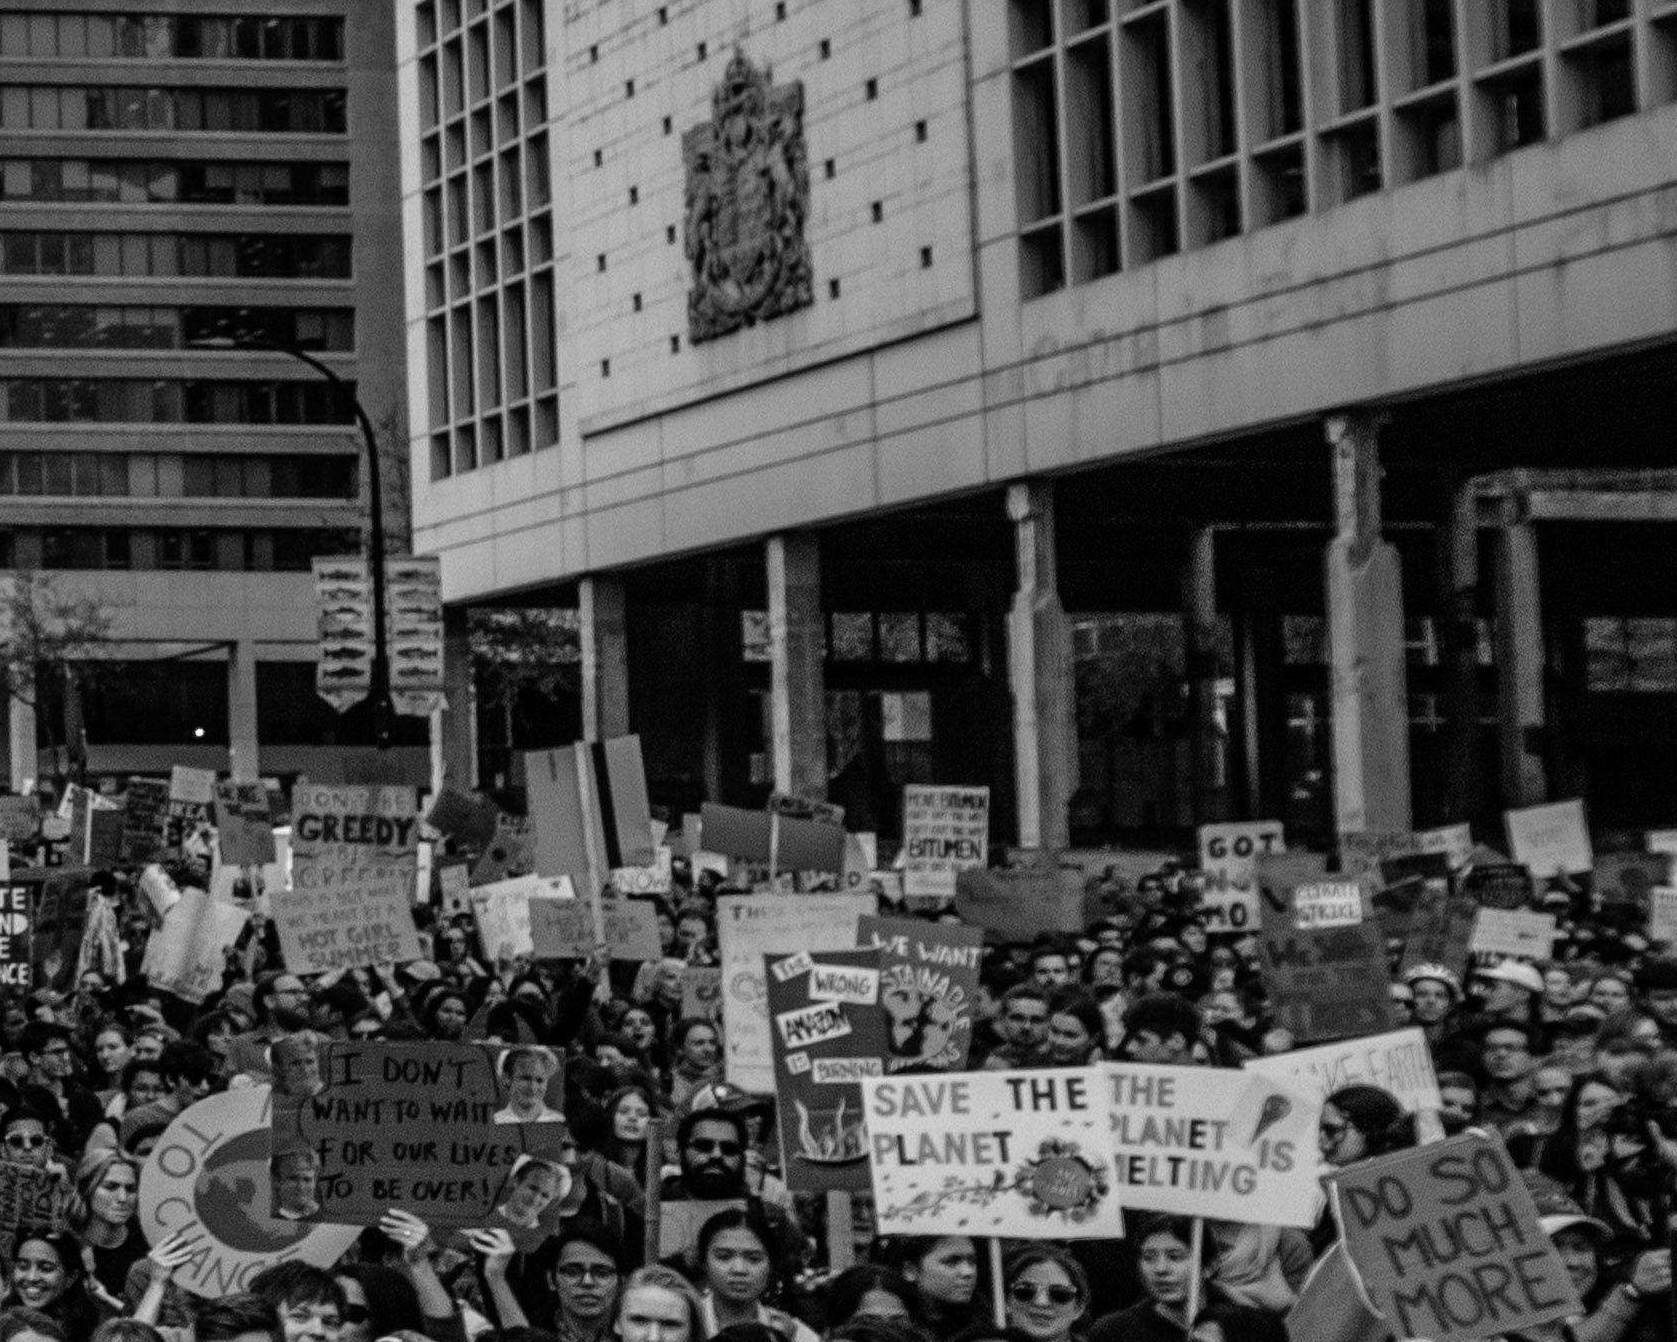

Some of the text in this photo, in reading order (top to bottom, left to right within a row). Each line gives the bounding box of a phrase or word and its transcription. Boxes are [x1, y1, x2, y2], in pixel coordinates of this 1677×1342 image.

[297, 813, 416, 846] GREEDY
[1208, 833, 1277, 859] GOT
[909, 838, 982, 860] BITUMEN
[297, 922, 401, 950] HOT GIRL
[871, 931, 984, 969] WE WANT
[307, 941, 403, 969] SUMMER
[814, 971, 872, 996] WRONG
[784, 1006, 845, 1044] AMAZON
[333, 1052, 476, 1089] I DON'T
[817, 1061, 880, 1077] BURNING
[873, 1078, 1088, 1118] SAVE THE
[1109, 1072, 1176, 1108] THE
[312, 1091, 497, 1125] WANT TO WAIT
[317, 1135, 517, 1167] FOR OUR LIVES
[873, 1131, 1012, 1166] PLANET
[1258, 1138, 1296, 1172] IS
[317, 1172, 490, 1205] TO BE OVER!
[1346, 1147, 1510, 1228] DO SO
[1384, 1202, 1525, 1276] MUCH
[1394, 1251, 1565, 1338] MORE
